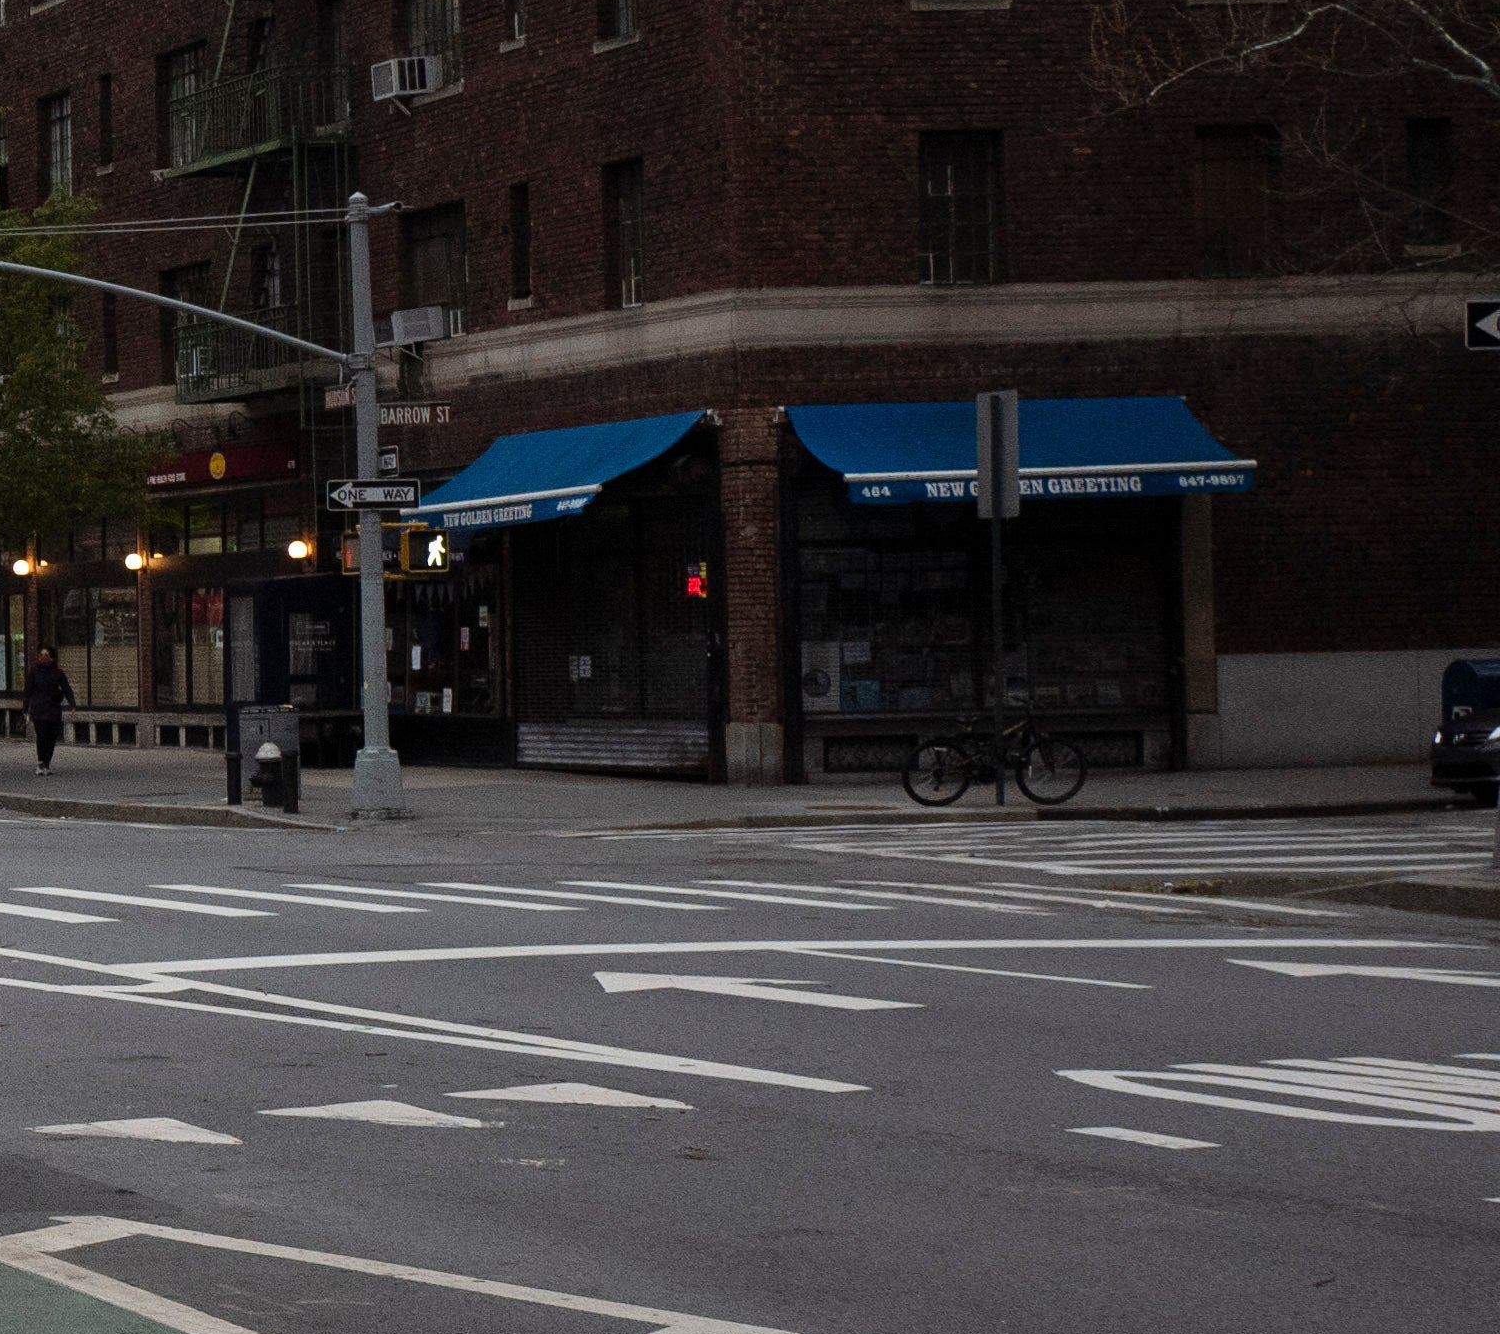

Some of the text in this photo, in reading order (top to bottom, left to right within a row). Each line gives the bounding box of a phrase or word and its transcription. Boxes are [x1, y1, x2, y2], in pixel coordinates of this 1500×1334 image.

[380, 406, 451, 425] BARROW ST
[337, 488, 411, 500] ONE WAY
[925, 481, 966, 499] NEW
[969, 478, 1044, 498] GEN
[1047, 476, 1142, 494] GREETING
[443, 513, 460, 528] NEW
[461, 509, 493, 526] GOLDEN
